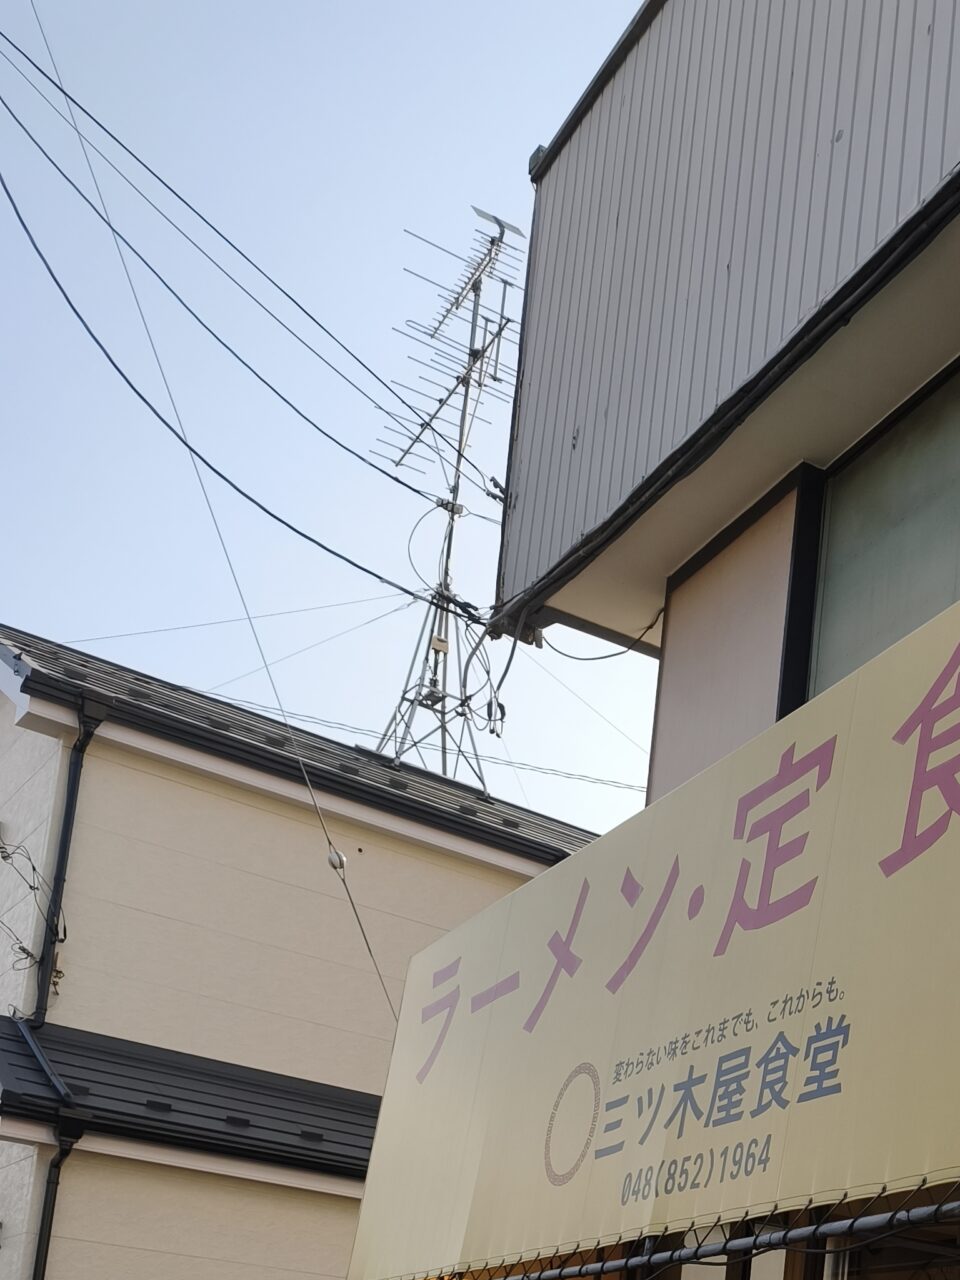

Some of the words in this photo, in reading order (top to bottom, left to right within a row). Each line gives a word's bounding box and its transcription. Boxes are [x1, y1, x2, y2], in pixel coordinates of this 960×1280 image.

[612, 976, 846, 1085] 変わらない味をこれまでも、これからも。
[594, 1013, 851, 1160] 三ツ木屋食堂
[620, 1134, 772, 1206] 048(852)1964
